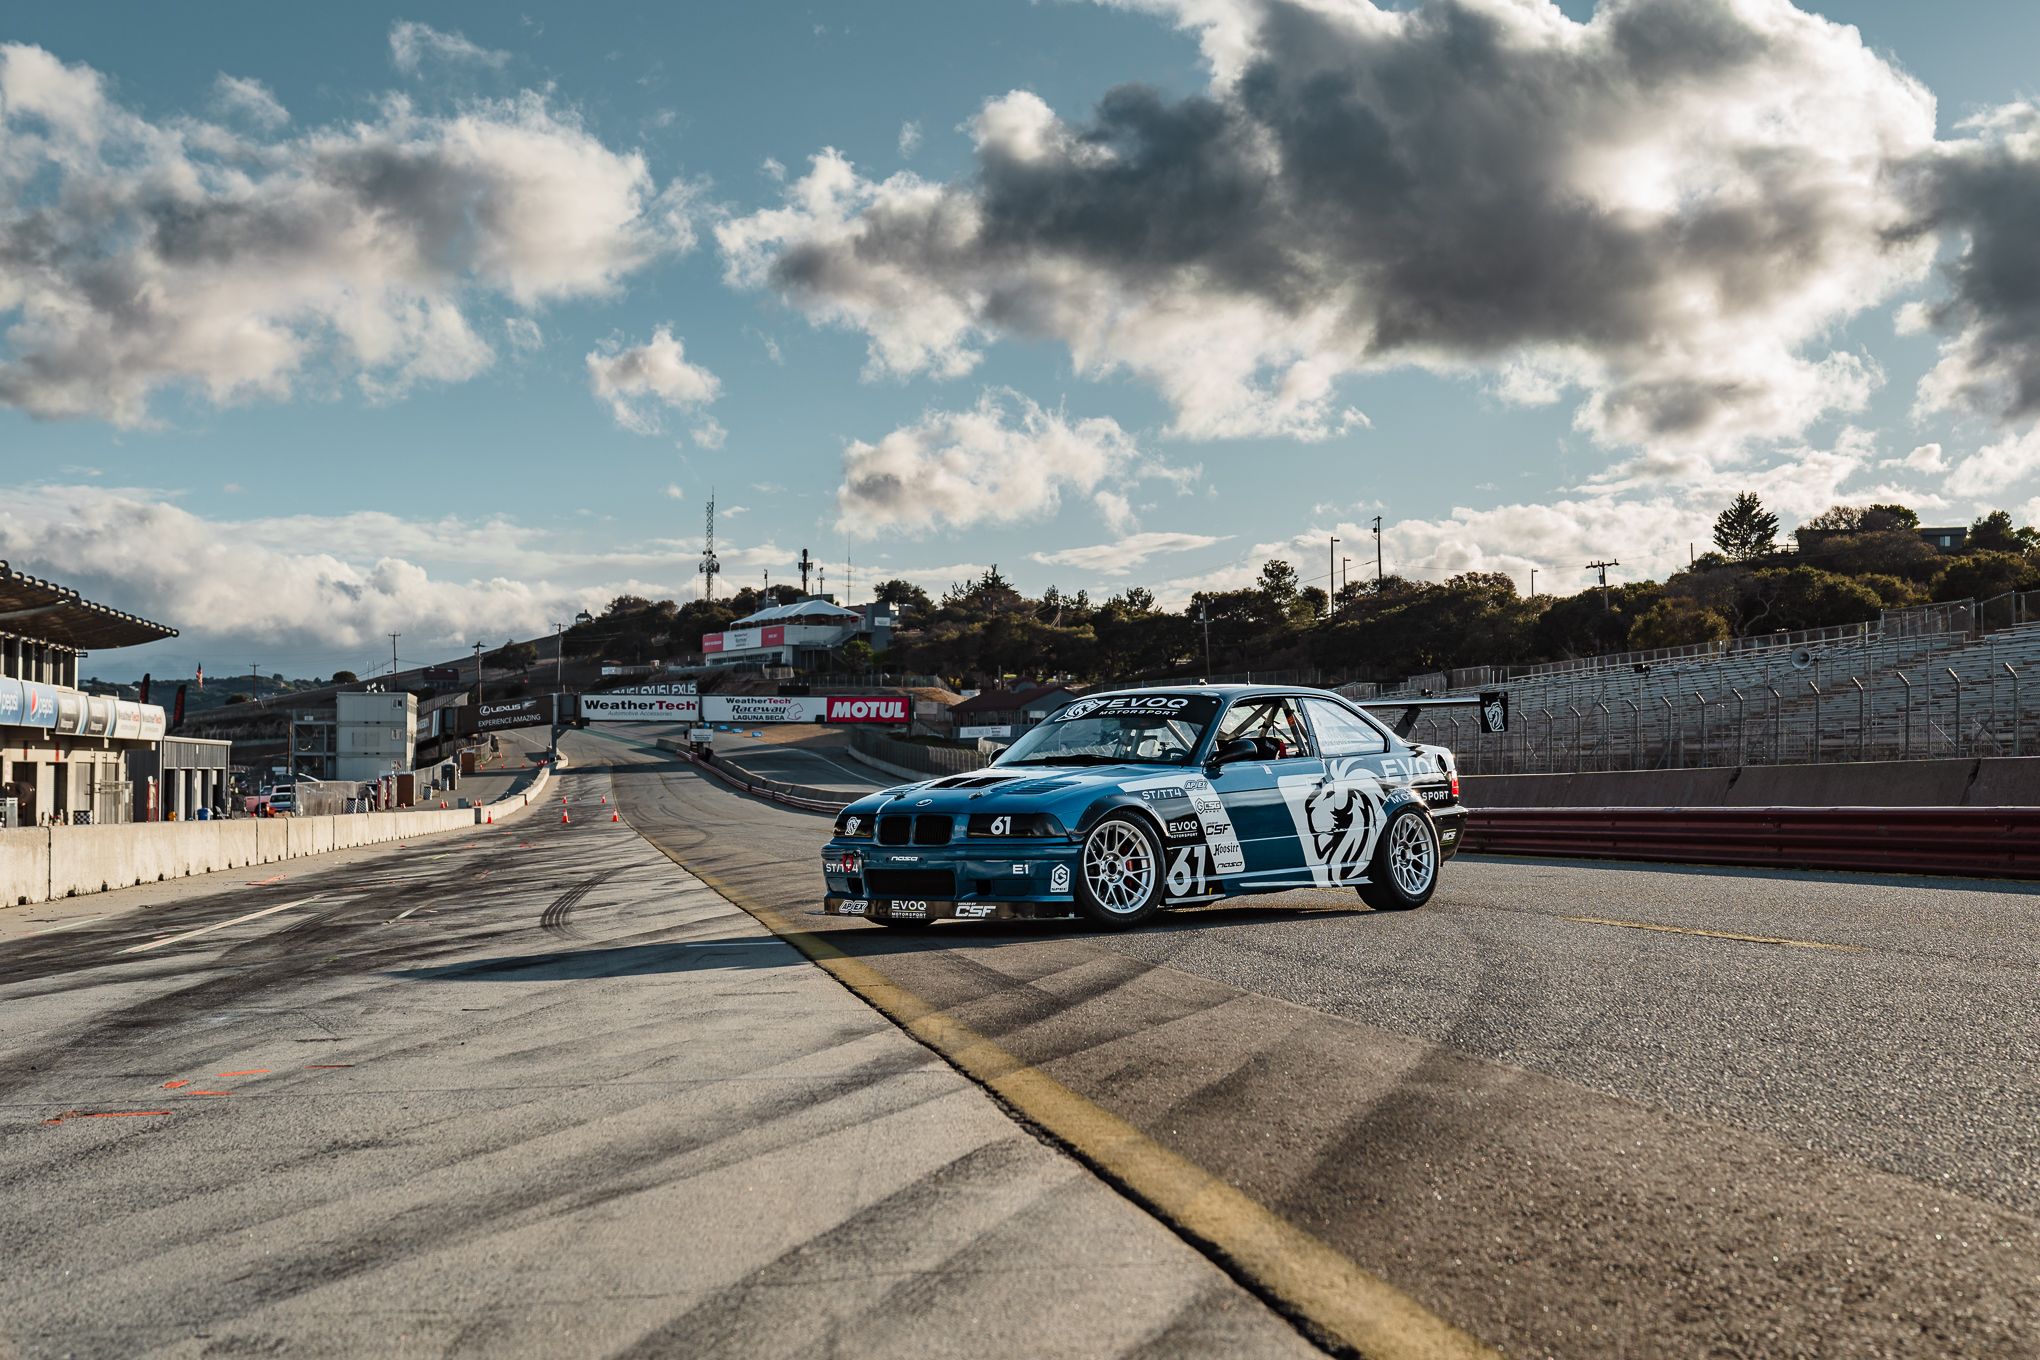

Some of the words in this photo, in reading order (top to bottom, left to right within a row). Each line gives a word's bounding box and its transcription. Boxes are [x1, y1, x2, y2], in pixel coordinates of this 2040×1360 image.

[37, 694, 54, 719] pepsi
[584, 700, 697, 710] WeatherTech
[725, 697, 791, 705] WeatherTech
[1106, 697, 1189, 709] EVOQ
[491, 703, 521, 713] LEXUS
[731, 704, 787, 714] Raceway
[831, 701, 905, 718] MOTUL
[478, 717, 513, 728] EXPERIENCE
[513, 713, 541, 723] AMAZING
[1141, 788, 1182, 800] ST/TT4
[990, 816, 1012, 835] 61
[1169, 820, 1198, 832] EVOQ
[1206, 823, 1231, 836] CSF
[1213, 842, 1239, 856] Hoosier
[825, 863, 859, 874] ST/T4
[1012, 864, 1029, 875] E1
[1166, 845, 1207, 896] 61
[891, 901, 927, 910] EVOQ
[955, 905, 996, 917] CSF
